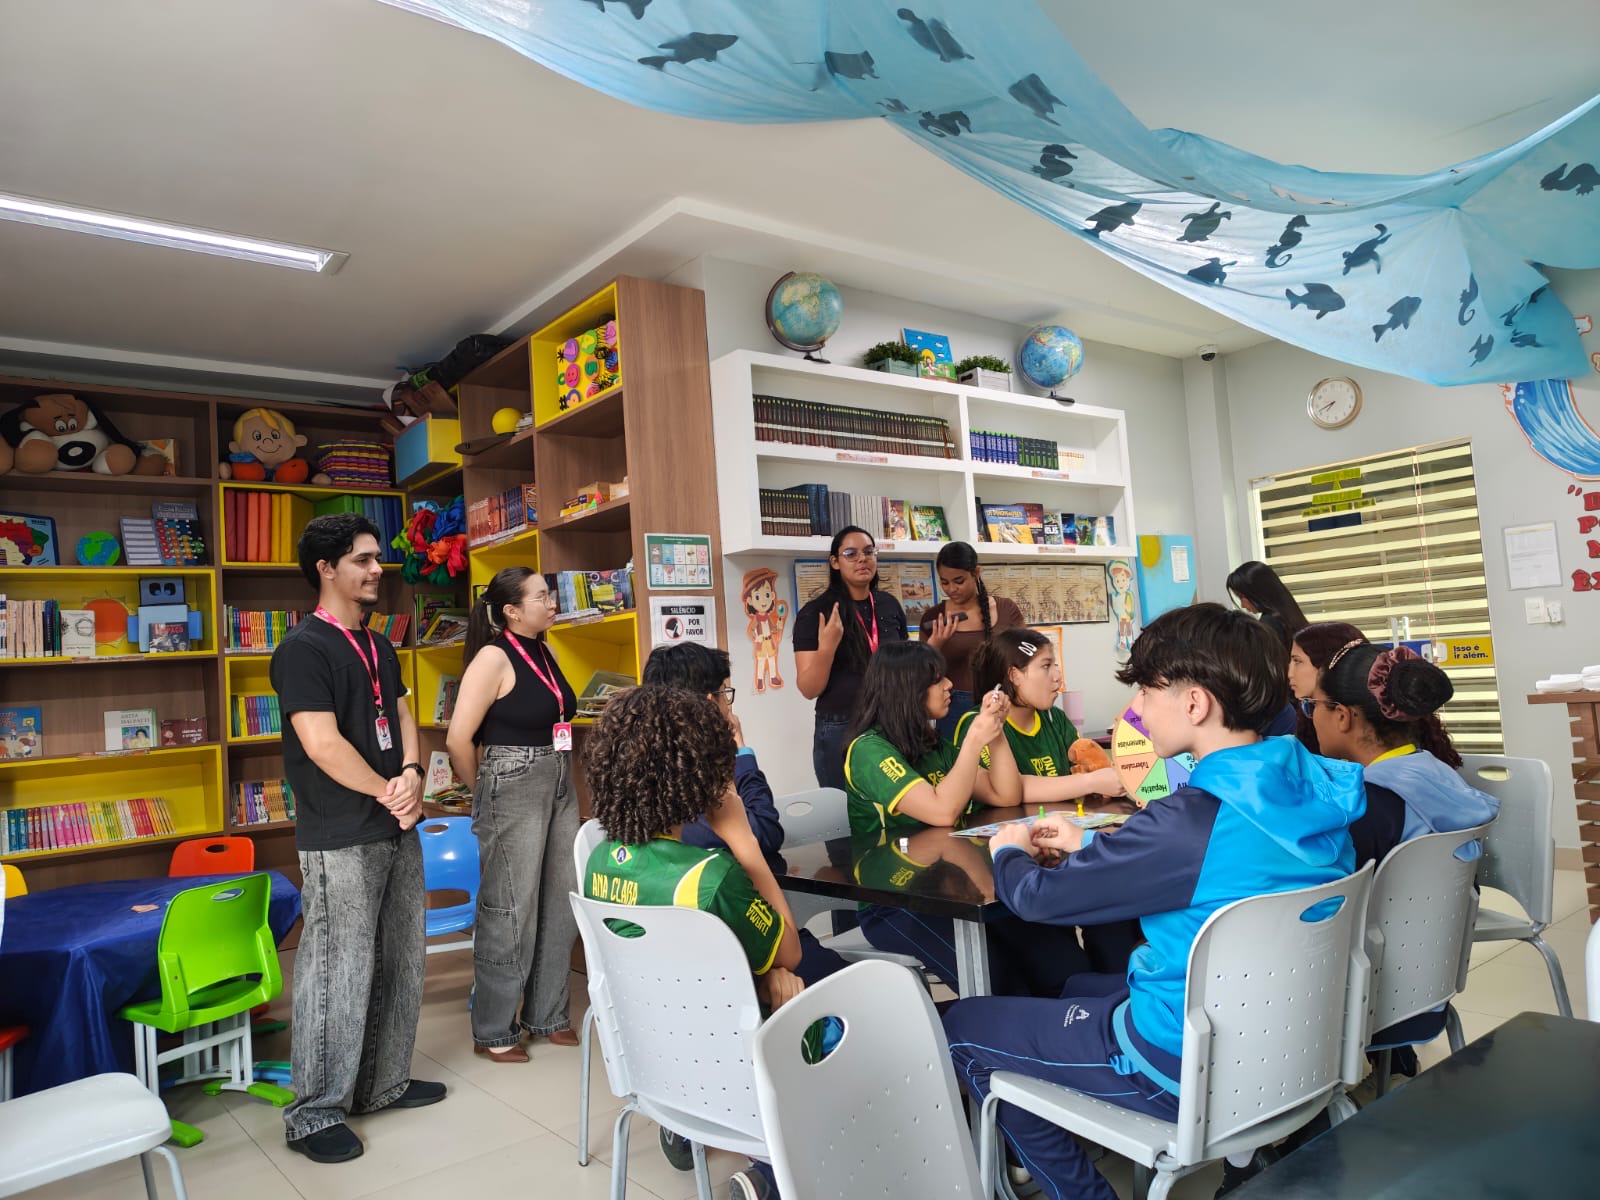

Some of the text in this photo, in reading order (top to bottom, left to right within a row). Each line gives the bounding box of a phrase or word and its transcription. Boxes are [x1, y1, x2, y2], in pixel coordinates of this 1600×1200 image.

[685, 627, 704, 636] FAVOR
[688, 618, 701, 626] POR
[592, 872, 639, 905] ANA CLARA
[745, 904, 769, 937] TURMA
